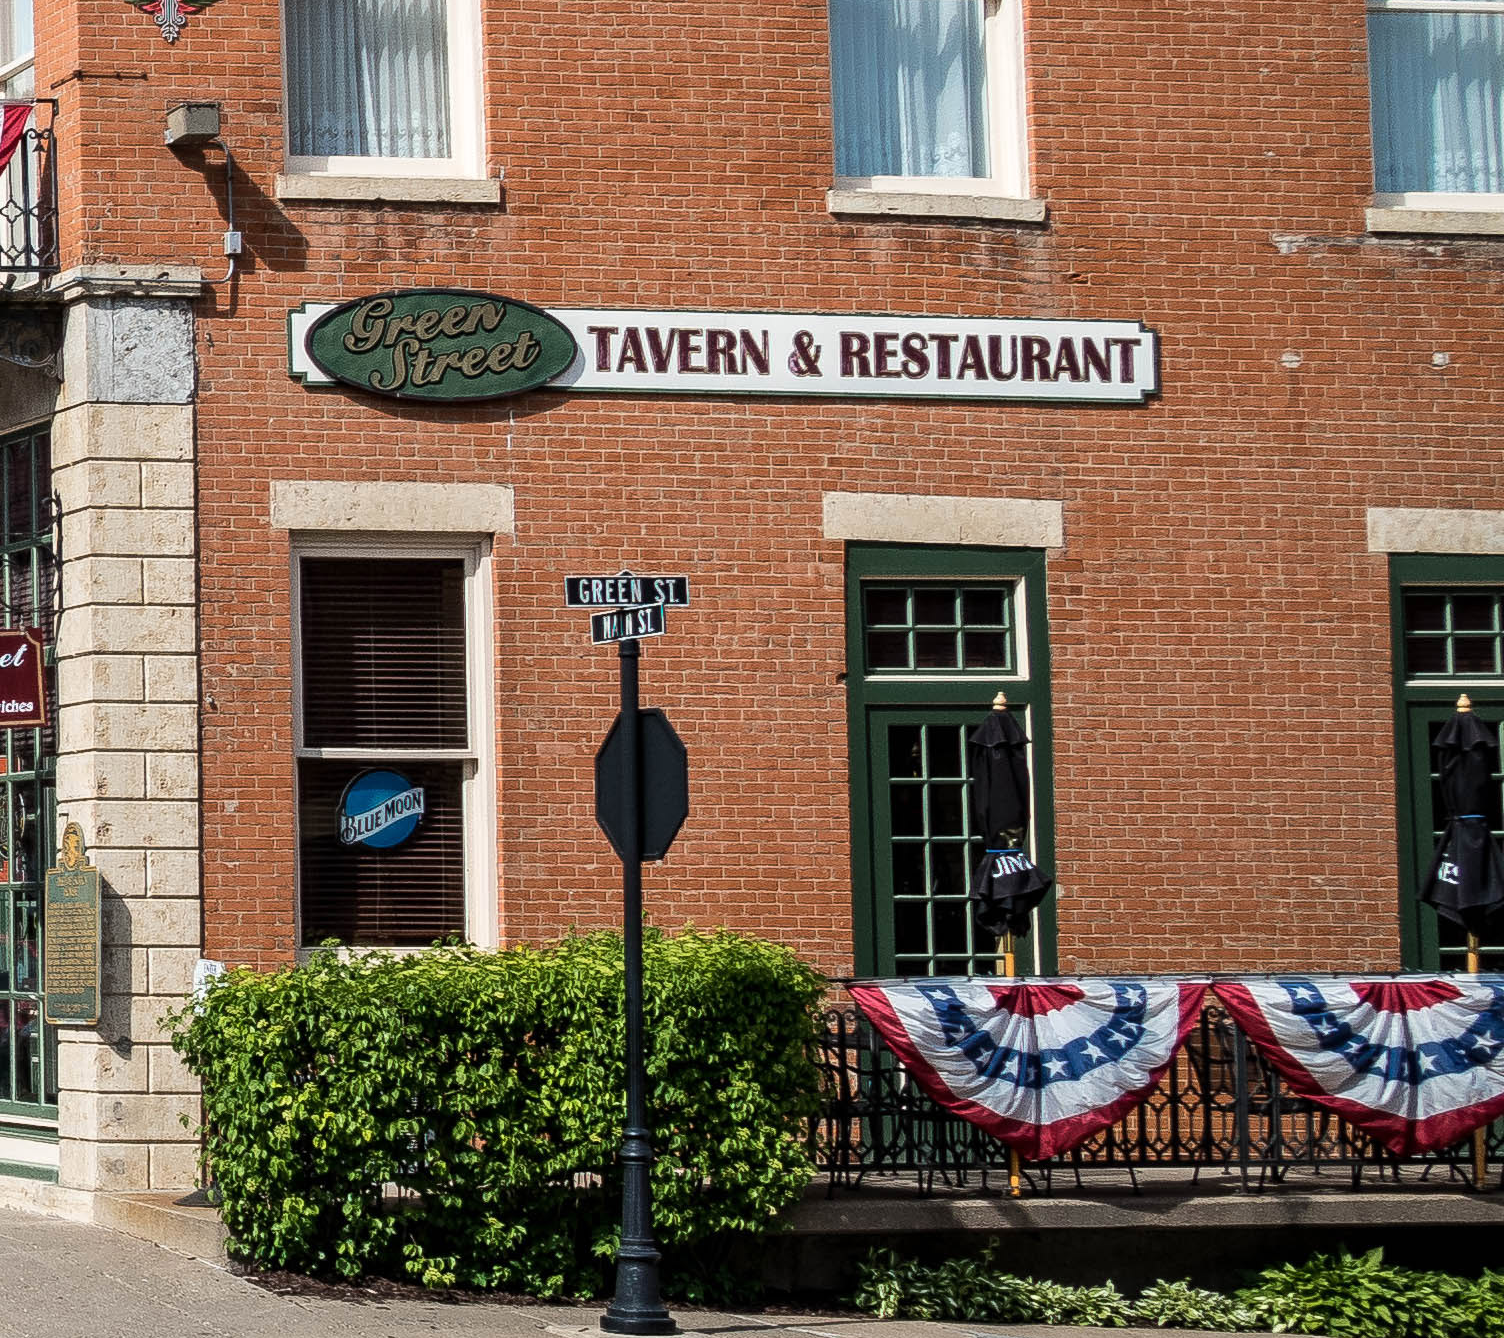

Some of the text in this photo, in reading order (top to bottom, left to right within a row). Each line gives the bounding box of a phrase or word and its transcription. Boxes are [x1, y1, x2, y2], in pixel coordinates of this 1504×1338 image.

[345, 296, 505, 353] Green
[371, 331, 540, 391] Street
[587, 325, 1141, 384] TAVERN & RESTAURANT
[579, 579, 679, 603] GREEN ST.
[603, 609, 655, 638] MAIN ST.
[341, 791, 423, 844] BLUE MOON
